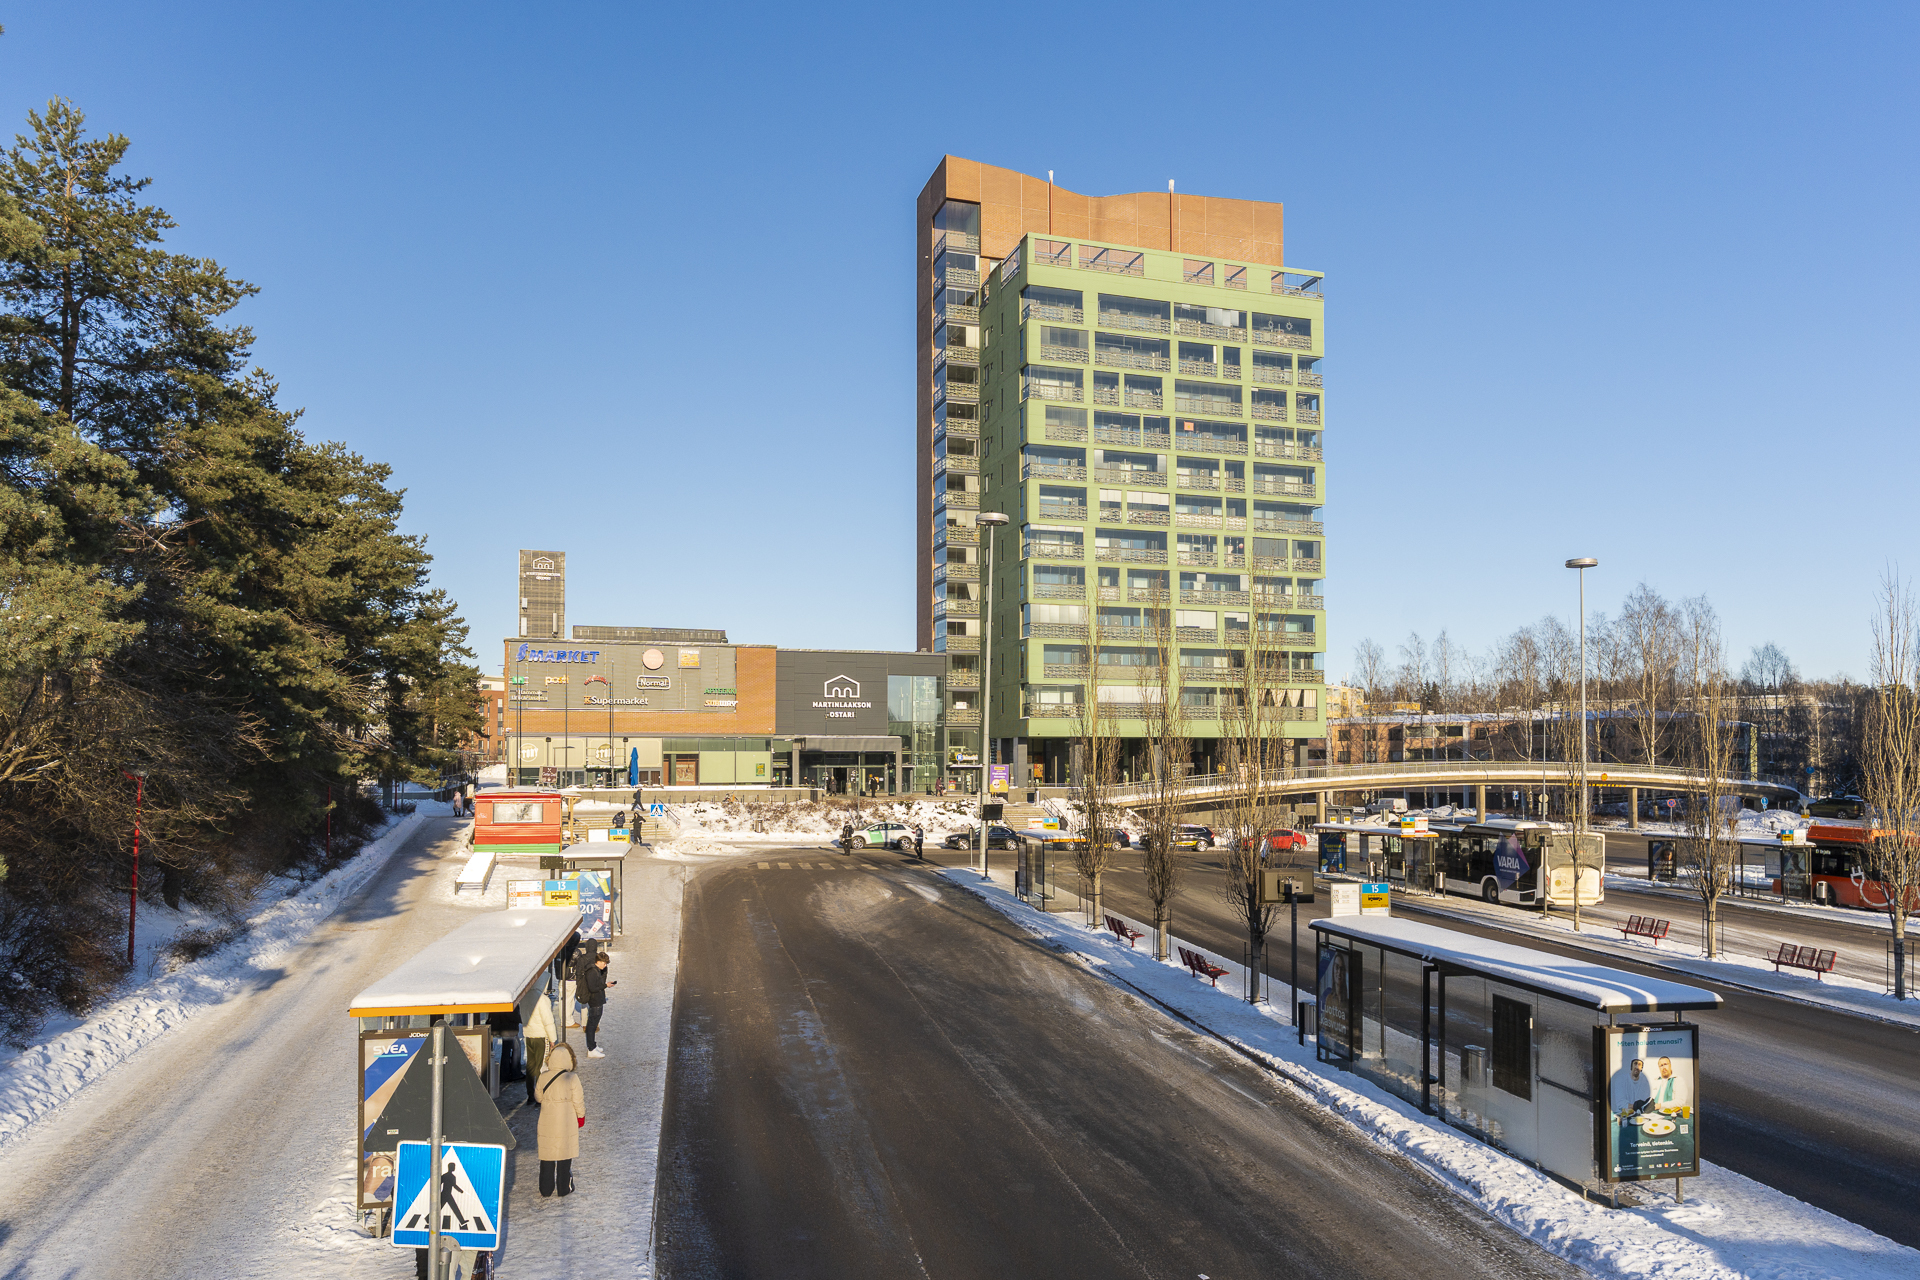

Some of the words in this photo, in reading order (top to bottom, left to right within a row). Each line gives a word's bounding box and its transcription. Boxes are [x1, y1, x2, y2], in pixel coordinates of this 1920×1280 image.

[680, 654, 700, 662] 24
[640, 678, 668, 688] Normal
[812, 701, 872, 709] MARTINLAAKSON
[1497, 855, 1521, 870] VARIA
[557, 881, 566, 890] 13
[1371, 884, 1379, 893] 15
[1320, 1000, 1346, 1020] Luottoa
[1657, 1037, 1683, 1045] munasi?
[373, 1044, 408, 1055] SVEA
